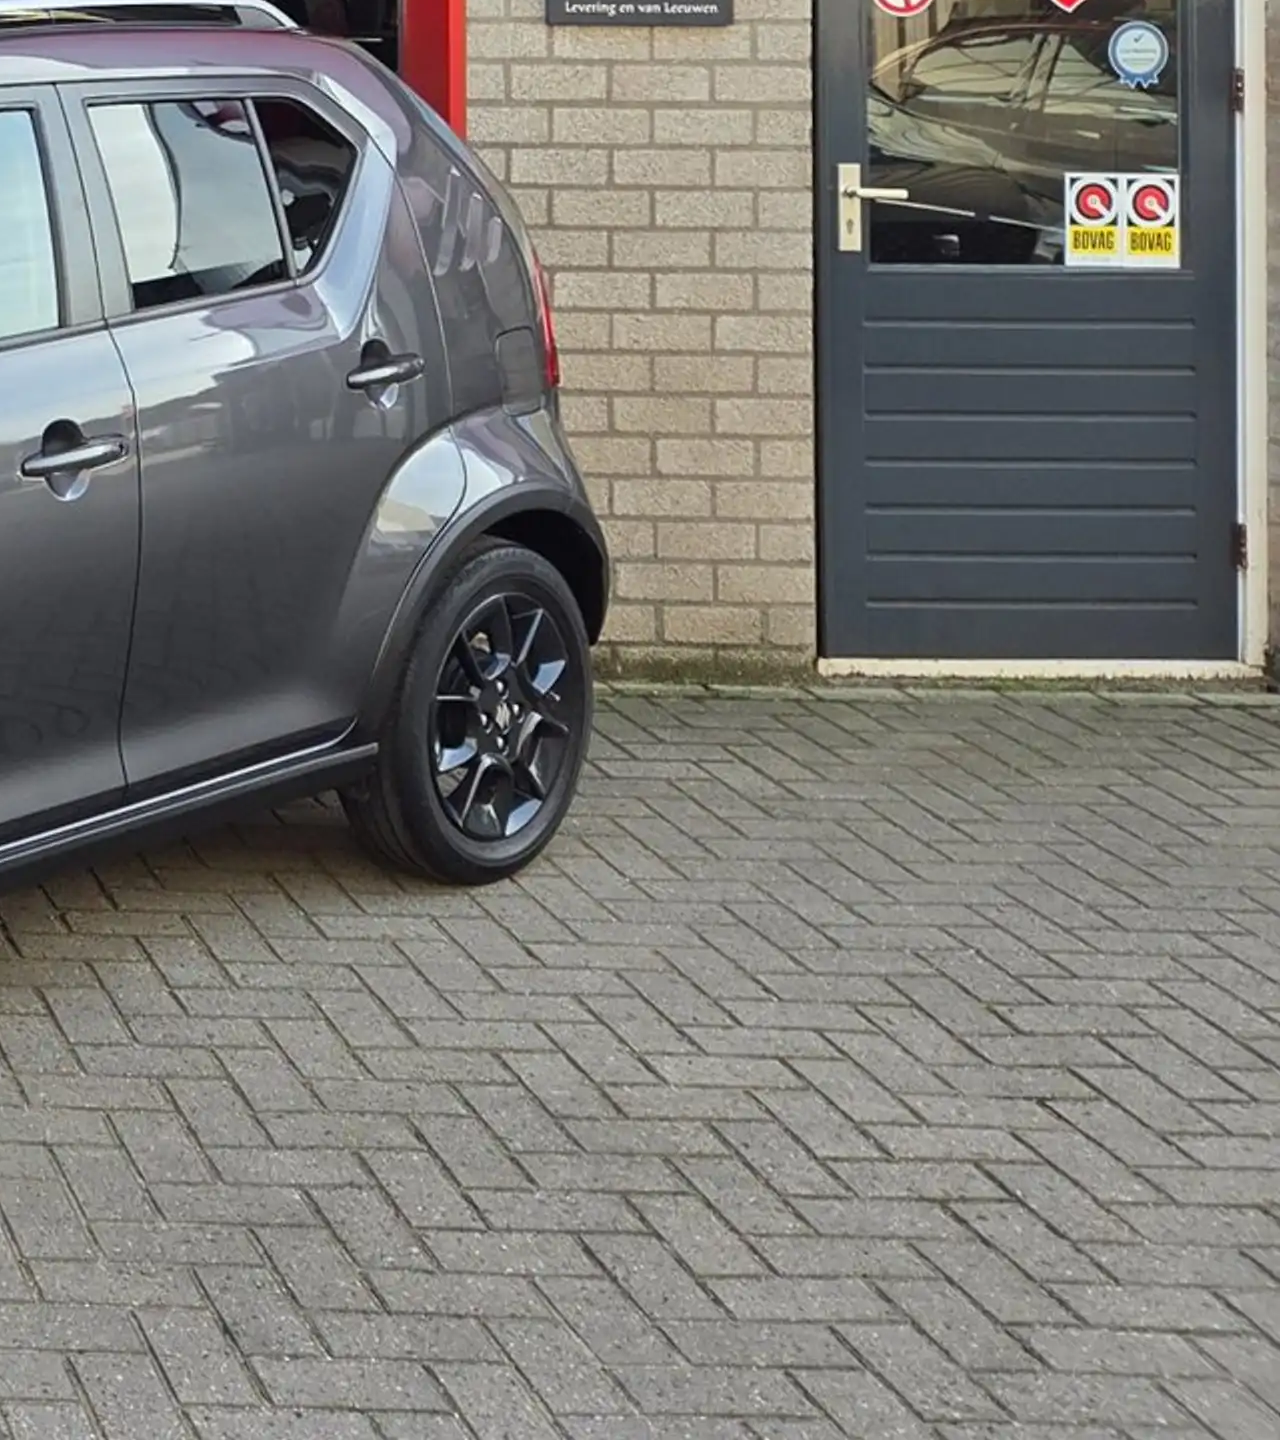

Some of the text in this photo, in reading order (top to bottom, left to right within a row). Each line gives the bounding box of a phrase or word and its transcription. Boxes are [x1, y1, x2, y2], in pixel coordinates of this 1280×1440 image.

[564, 1, 719, 18] Levering en van Leeuwen
[1072, 230, 1115, 250] BOVAG
[1130, 231, 1173, 252] BOVAG
